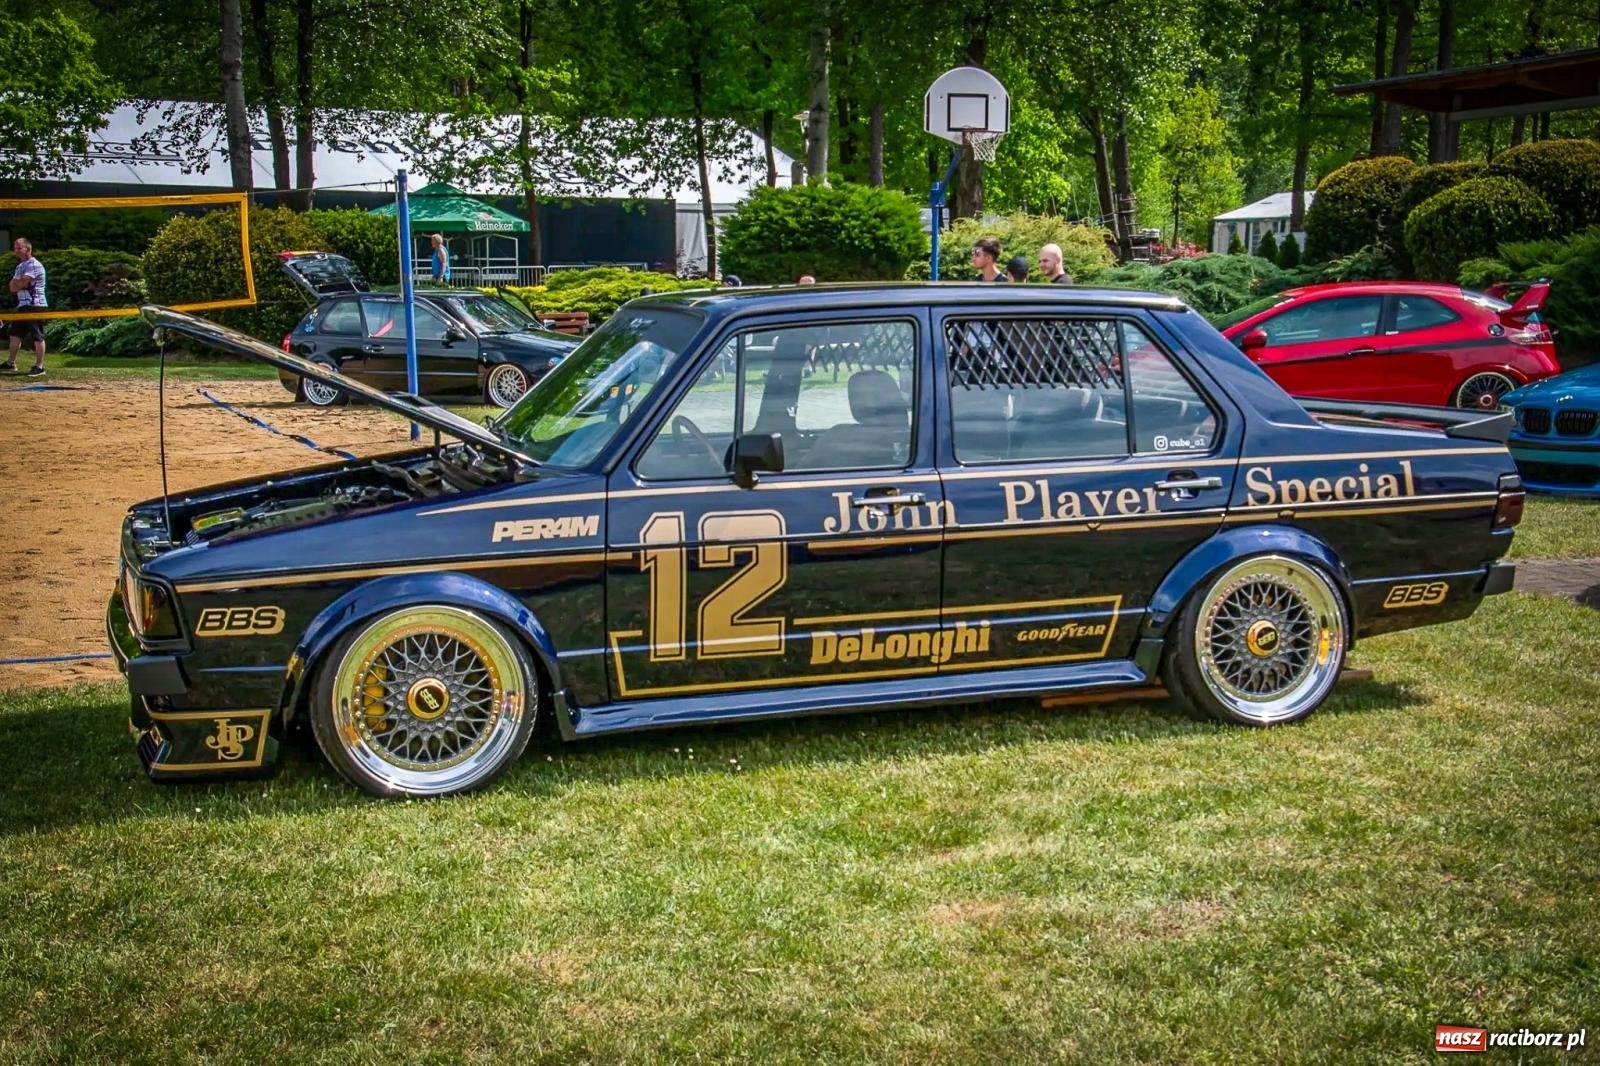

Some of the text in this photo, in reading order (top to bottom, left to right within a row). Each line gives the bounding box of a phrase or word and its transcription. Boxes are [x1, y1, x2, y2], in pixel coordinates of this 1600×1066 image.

[475, 220, 514, 231] Heineken
[999, 479, 1167, 523] Player
[1245, 460, 1416, 506] Special
[639, 509, 786, 662] 12
[1383, 581, 1449, 609] BBS
[195, 605, 286, 637] BBS
[810, 619, 991, 665] DeLonghi
